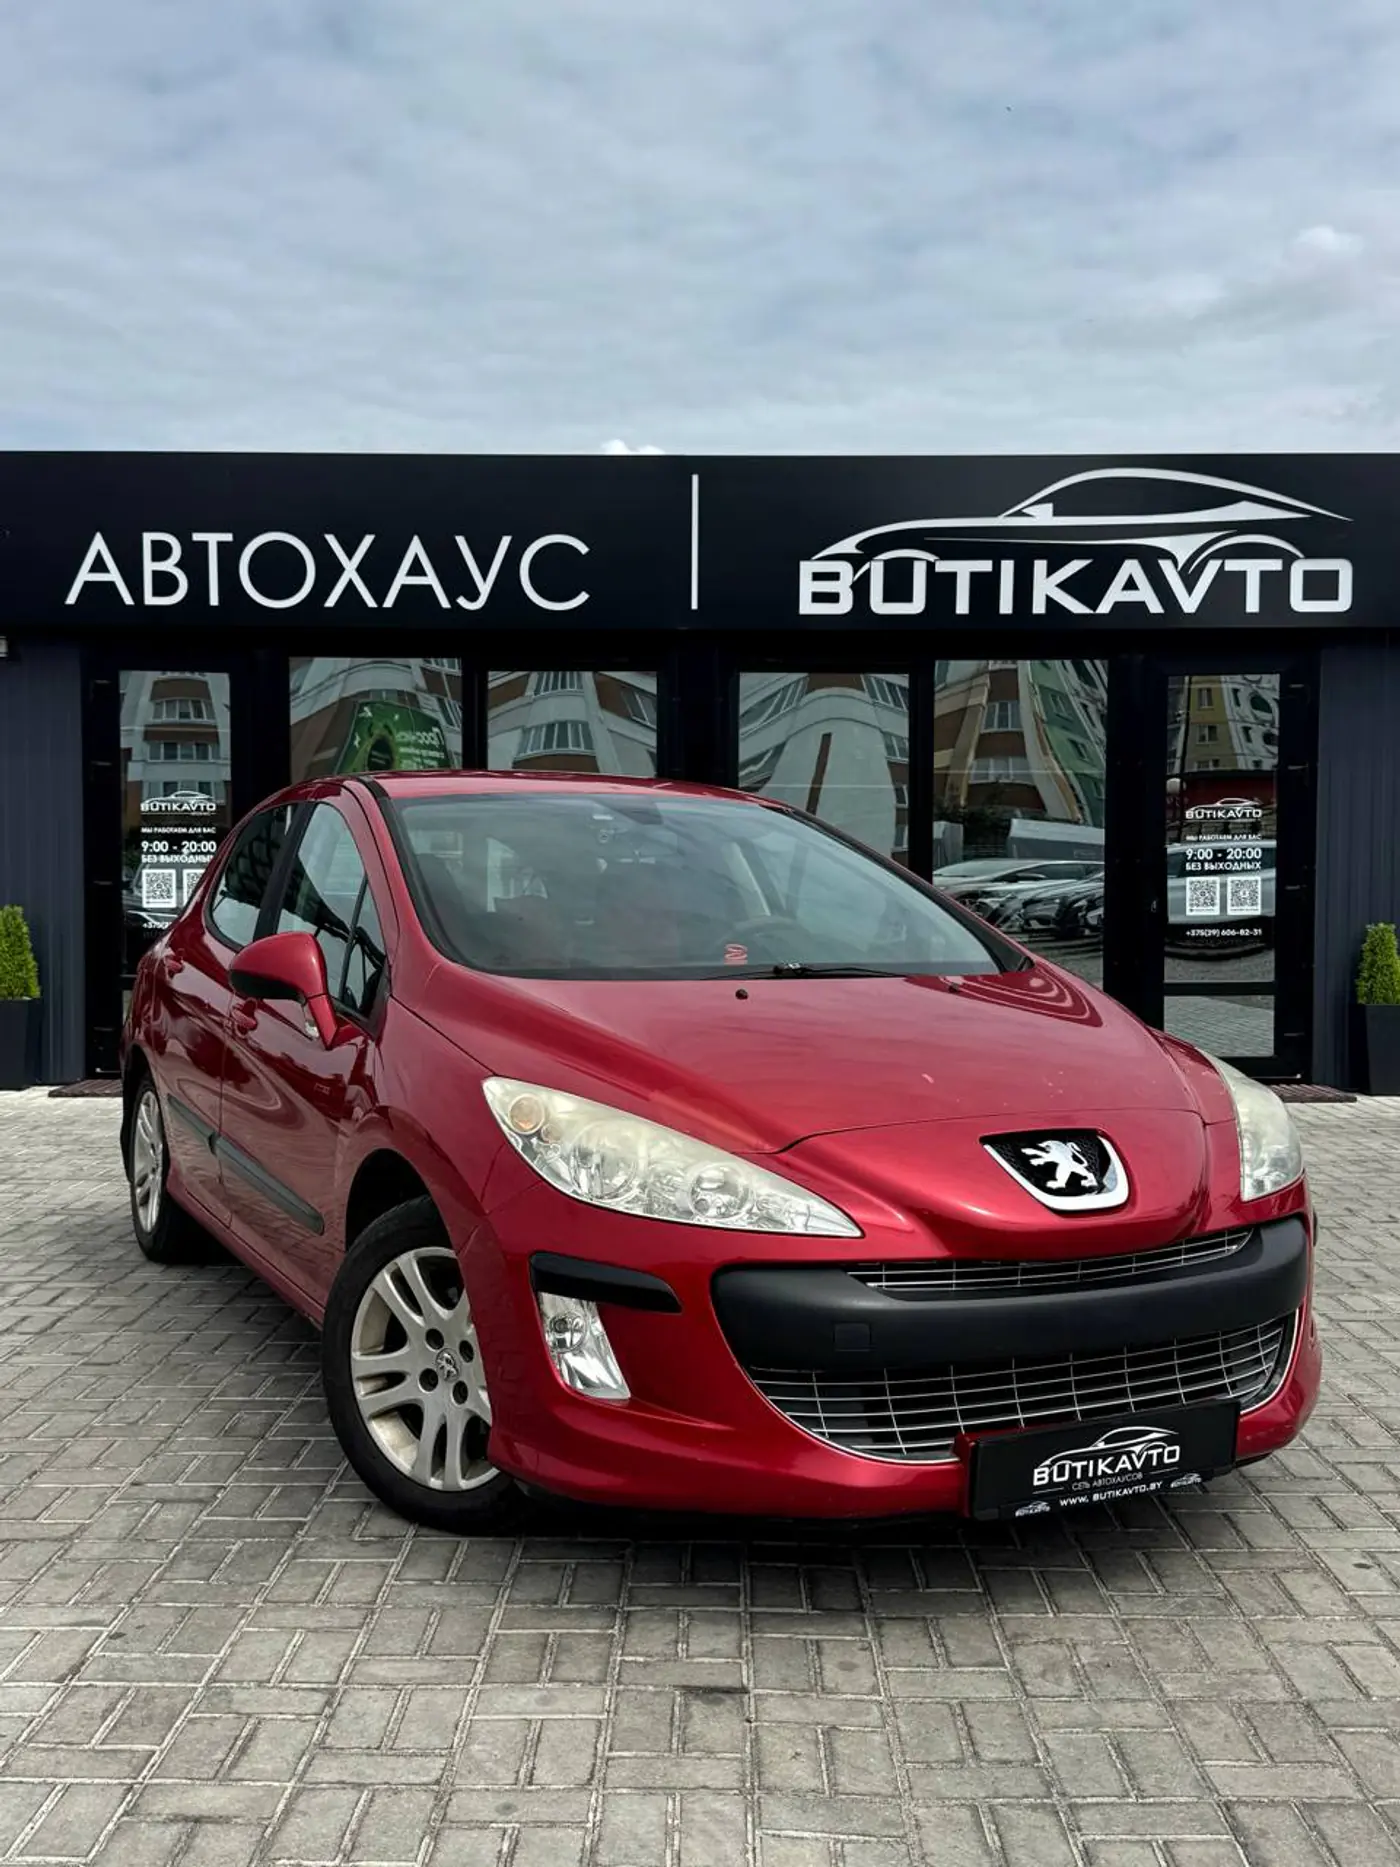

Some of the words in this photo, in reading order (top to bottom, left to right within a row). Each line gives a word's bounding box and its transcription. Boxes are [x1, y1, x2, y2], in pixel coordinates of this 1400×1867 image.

[65, 532, 590, 611] АВТОХАУС
[799, 557, 1353, 615] BUTIKAVTO
[140, 802, 216, 812] BUTIKAVTO
[1185, 809, 1262, 819] BUTIKAVTO
[141, 840, 169, 853] 9:00
[181, 840, 217, 853] 20:00
[141, 854, 158, 863] БЕЗ
[1186, 848, 1213, 860] 9:00
[1226, 847, 1262, 859] 20:00
[1186, 862, 1202, 871] БЕЗ
[1203, 861, 1262, 871] ВЫХОДНЫХ
[1186, 929, 1220, 937] +375(29)
[1033, 1445, 1180, 1486] BUTIKAVTO
